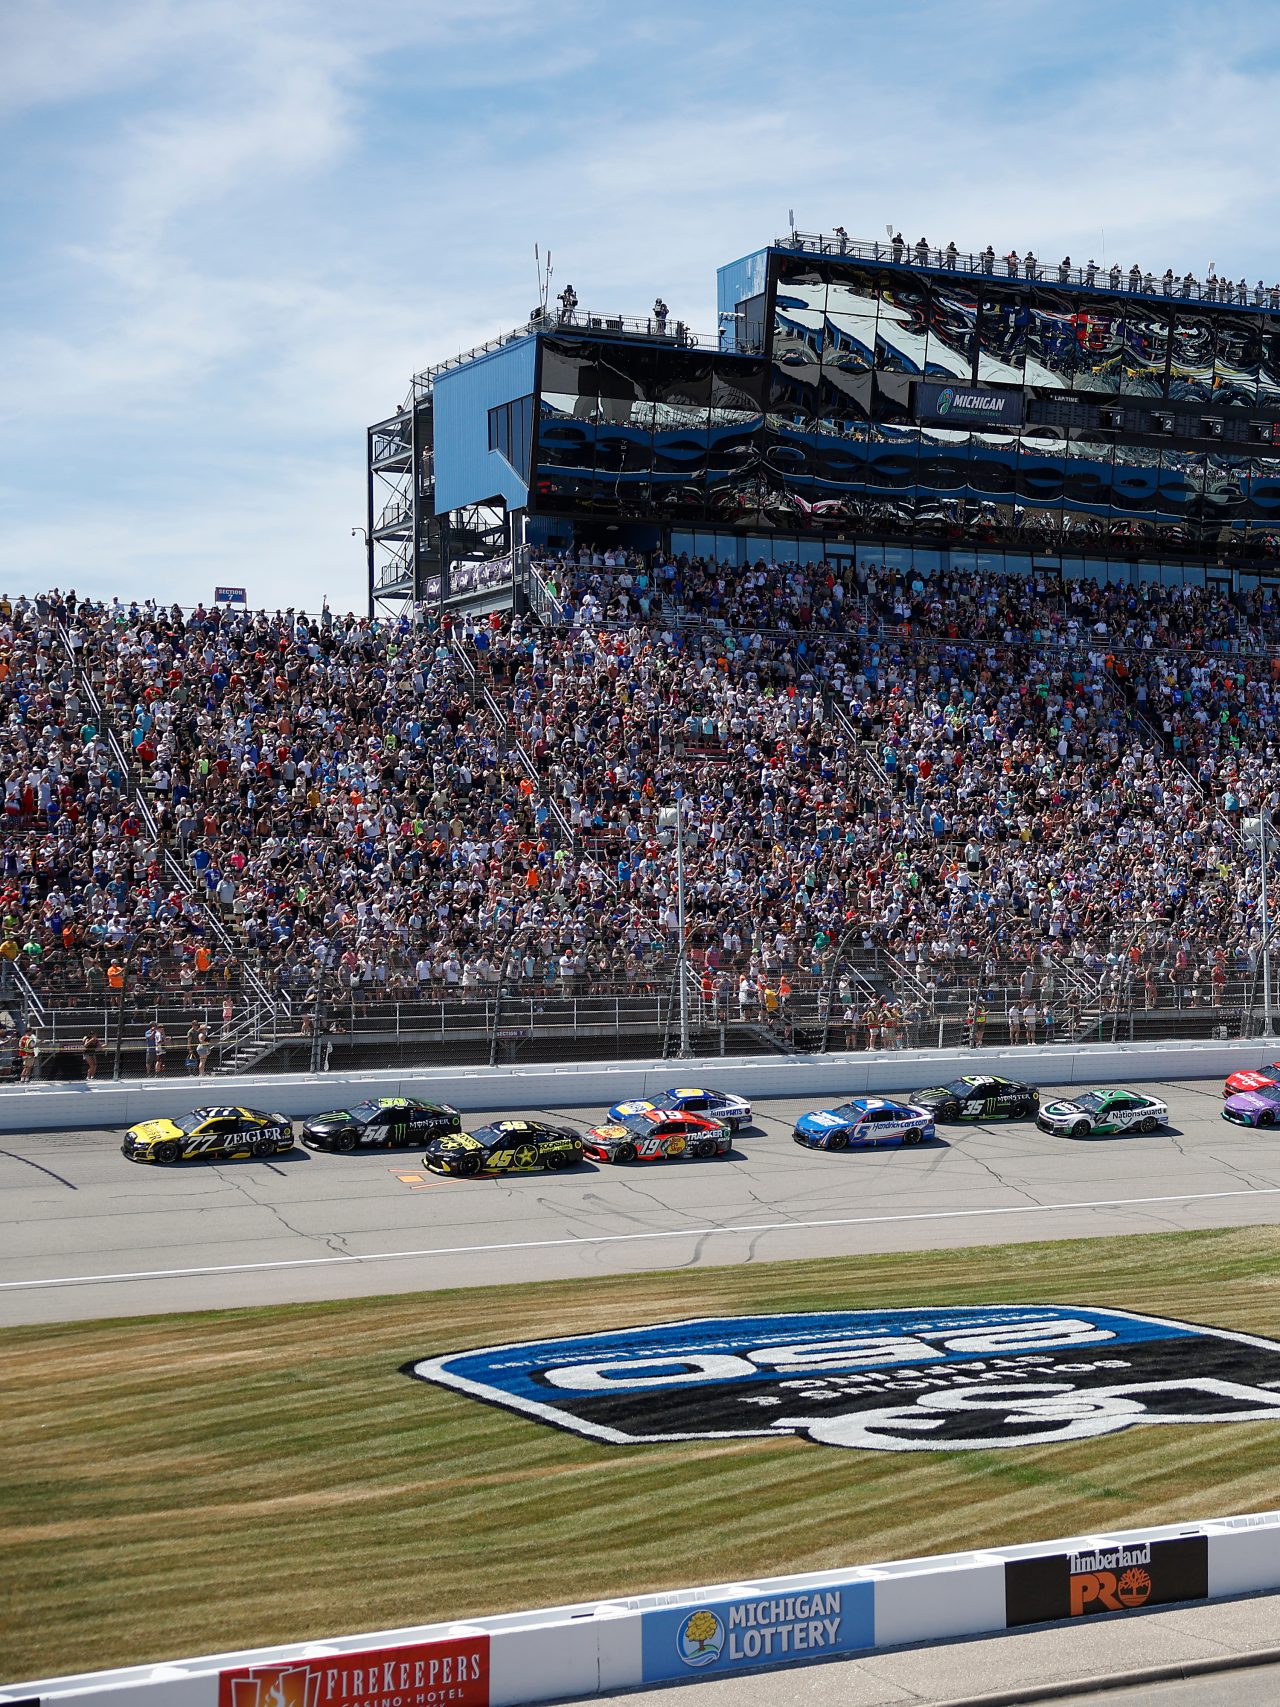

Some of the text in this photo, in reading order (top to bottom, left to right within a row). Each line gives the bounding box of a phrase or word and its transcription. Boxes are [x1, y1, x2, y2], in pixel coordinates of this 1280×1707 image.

[953, 395, 1005, 411] MICHIGAN
[1165, 420, 1172, 430] 2
[1214, 424, 1222, 434] 3
[1262, 428, 1270, 438] 4
[997, 1093, 1030, 1101] MONSTER
[207, 1107, 234, 1117] 77
[655, 1110, 682, 1120] 19
[726, 1108, 743, 1116] PARTS
[962, 1100, 985, 1115] 35
[409, 1118, 450, 1129] MONSTER
[223, 1128, 282, 1147] ZEIGLER
[360, 1125, 389, 1142] 54
[686, 1130, 723, 1140] TRACKER
[856, 1125, 872, 1139] 5
[185, 1135, 218, 1153] 77
[640, 1139, 660, 1155] 19
[486, 1150, 515, 1167] 45
[540, 1318, 1116, 1391] 250
[779, 1355, 1055, 1389] STAFFING
[737, 1359, 1133, 1407] SOLUTIONS &
[1066, 1543, 1151, 1574] Timberland
[729, 1591, 841, 1629] MICHIGAN
[729, 1617, 841, 1660] LOTTERY
[326, 1653, 480, 1700] FIREKEEPERS
[417, 1688, 464, 1704] HOTEL
